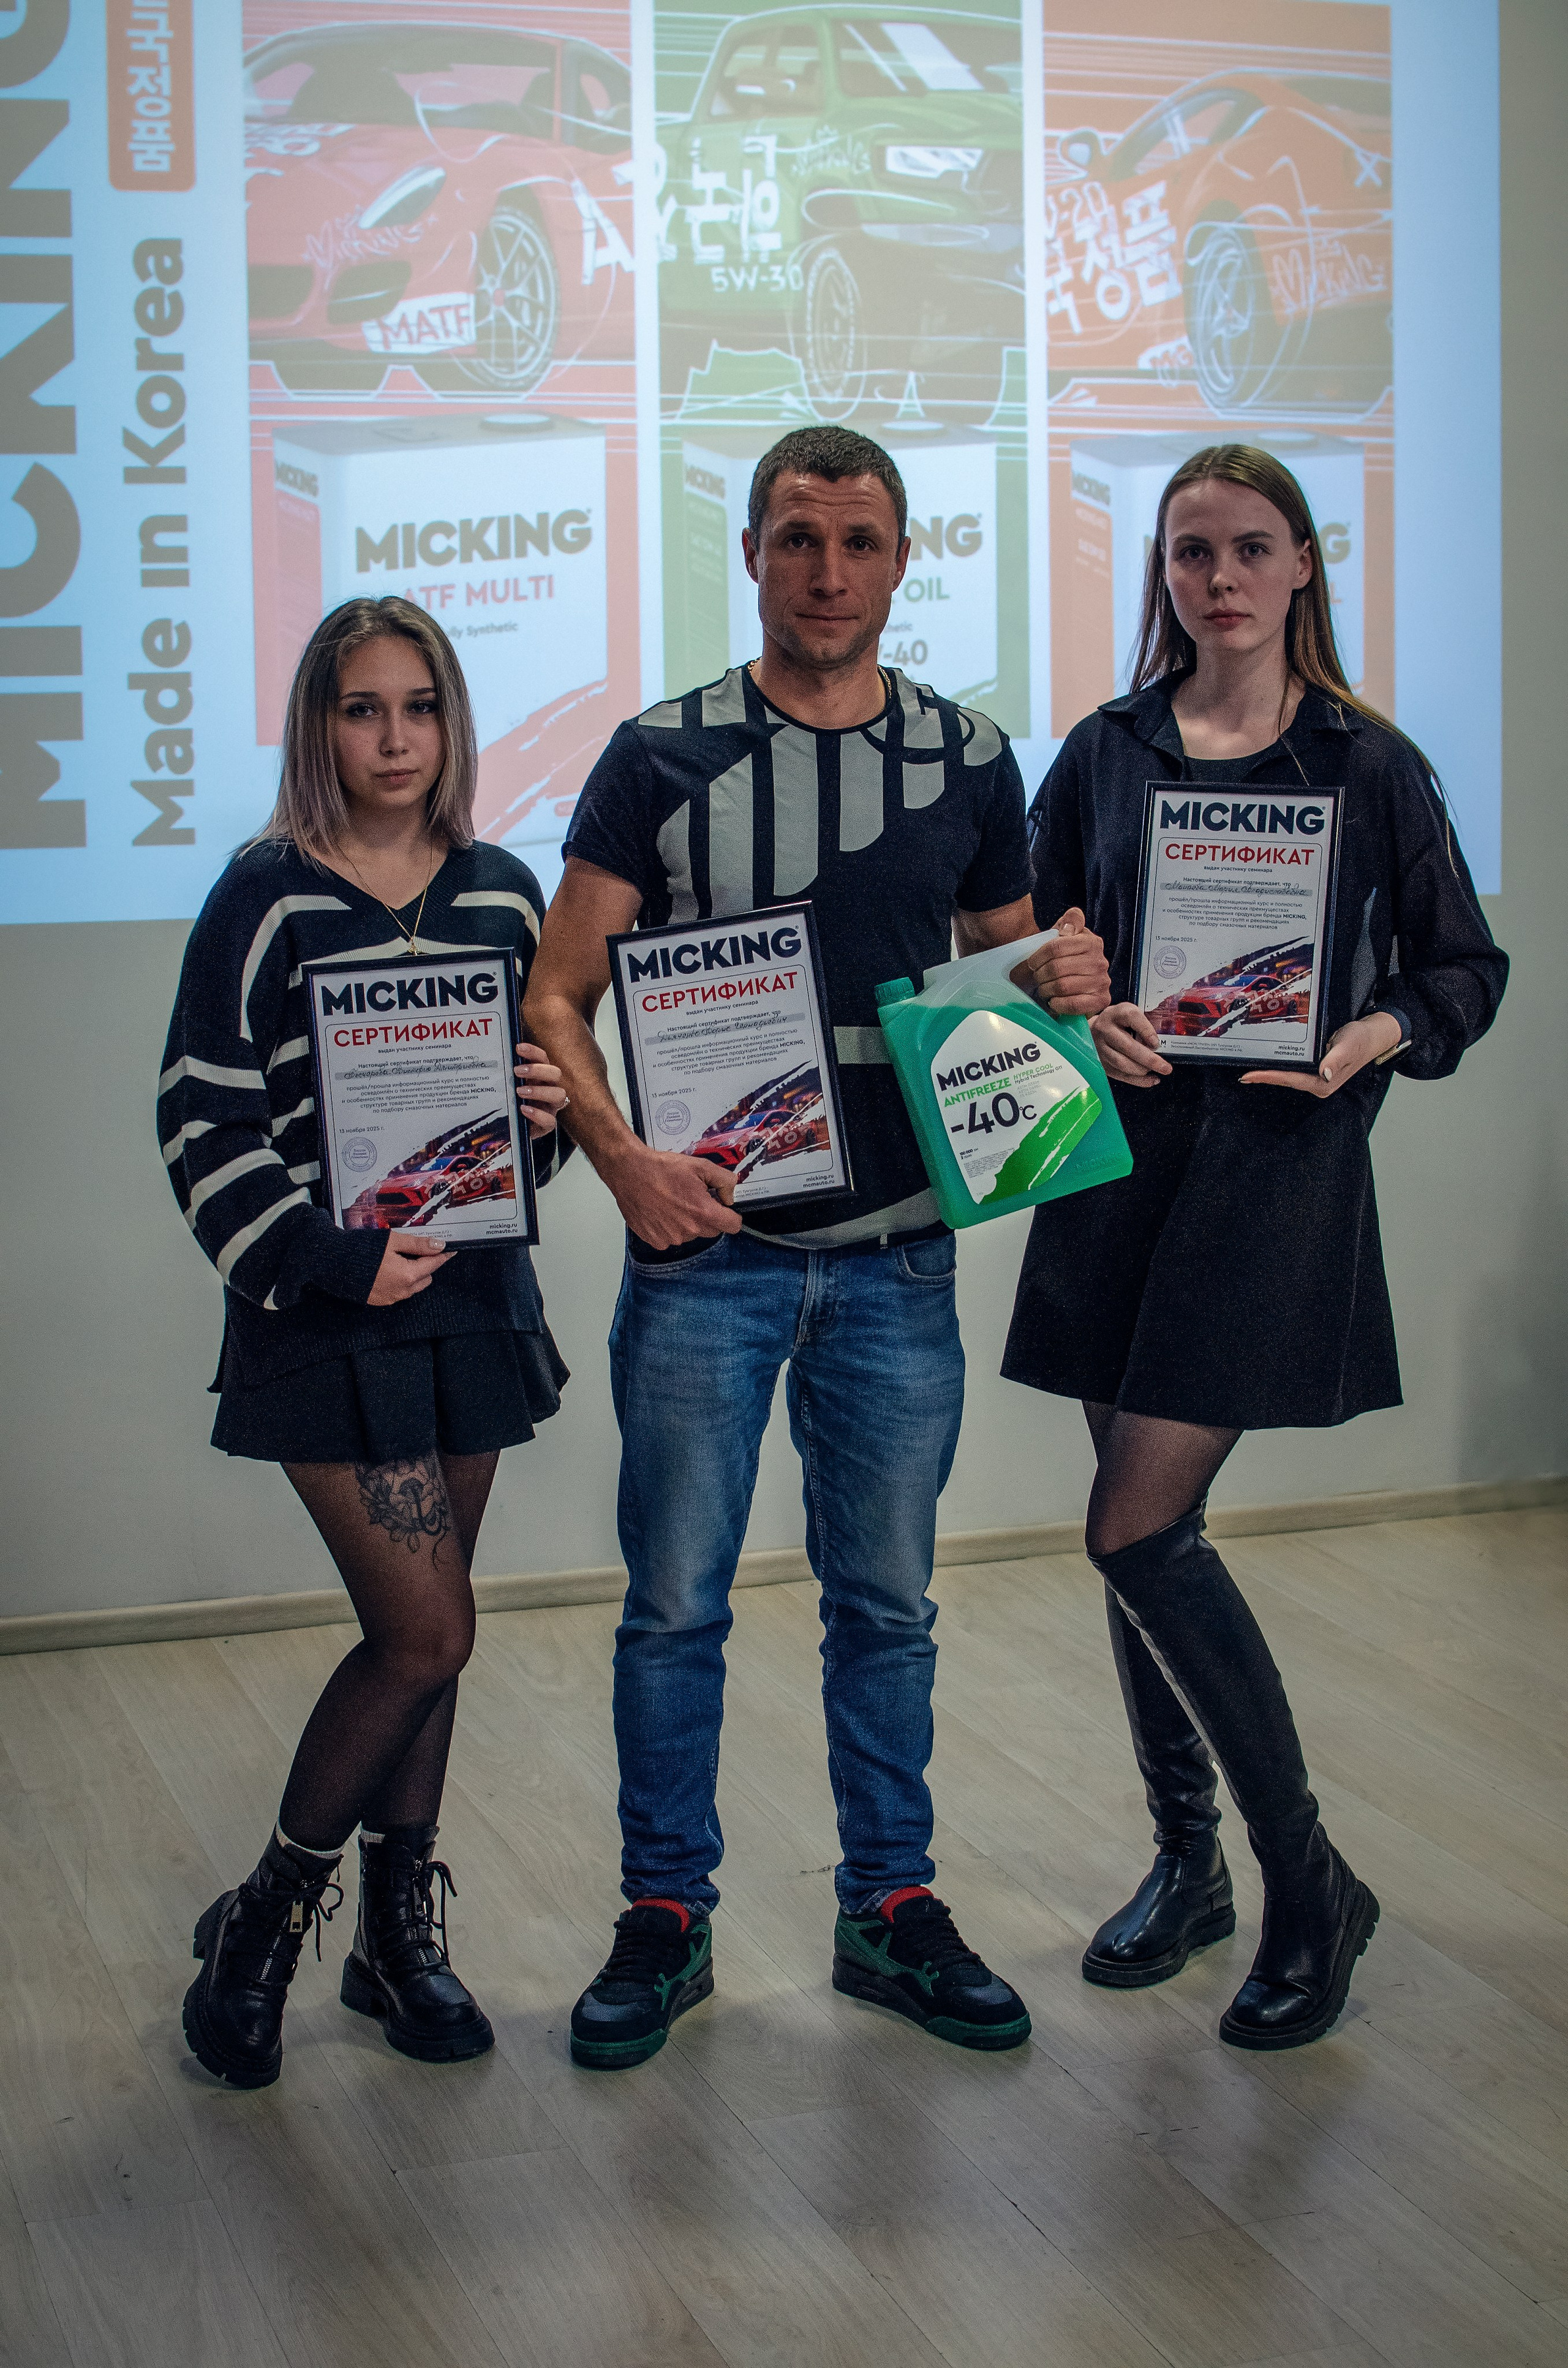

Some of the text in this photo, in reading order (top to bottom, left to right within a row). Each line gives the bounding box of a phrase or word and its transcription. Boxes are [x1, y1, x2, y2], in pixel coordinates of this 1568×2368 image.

[126, 0, 176, 172] 국정품
[710, 264, 804, 293] 5W-30
[375, 304, 470, 351] MATF
[123, 237, 197, 847] Made in Korea
[355, 508, 593, 573] MICKING
[466, 574, 555, 607] MULTI
[903, 577, 951, 603] OIL
[1159, 800, 1325, 835] MICKING
[1165, 843, 1314, 865] СЕРТИФИКАТ
[627, 925, 801, 983] MICKING
[320, 972, 498, 1016] MICKING
[642, 971, 797, 1012] СЕРТИФИКАТ
[667, 1022, 697, 1032] Настоящий
[698, 1018, 729, 1027] сертификат
[730, 1012, 770, 1021] подтверждает,
[703, 1004, 731, 1013] участнику
[334, 1018, 492, 1047] СЕРТИФИКАТ
[701, 1035, 748, 1048] информационный
[743, 1037, 785, 1047] преимуществах
[657, 1058, 694, 1067] особенностях
[695, 1052, 728, 1061] применения
[747, 1049, 788, 1059] рекомендациях
[936, 1043, 1041, 1091] MICKING
[392, 1078, 440, 1088] информационный
[1013, 1063, 1054, 1080] HYPER COOL
[1014, 1075, 1030, 1085] Hybrid
[1030, 1068, 1055, 1079] Technology
[944, 1077, 1012, 1108] ANTIFREEZE
